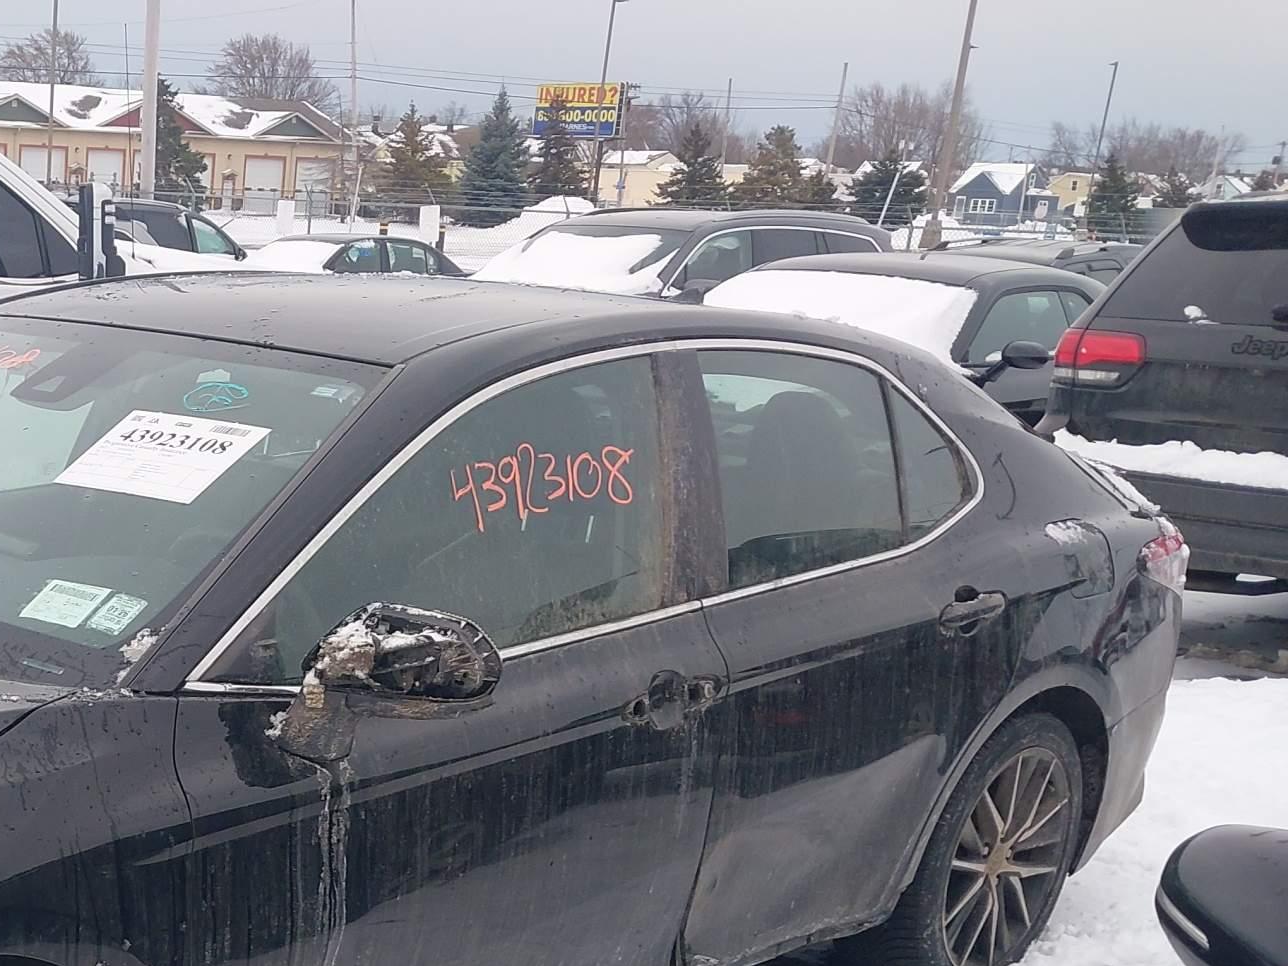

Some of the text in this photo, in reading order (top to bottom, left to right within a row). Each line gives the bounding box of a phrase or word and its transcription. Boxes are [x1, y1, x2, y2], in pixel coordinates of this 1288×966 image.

[1231, 334, 1288, 360] Jeep
[120, 428, 233, 455] 43923108
[450, 443, 635, 532] 43923108
